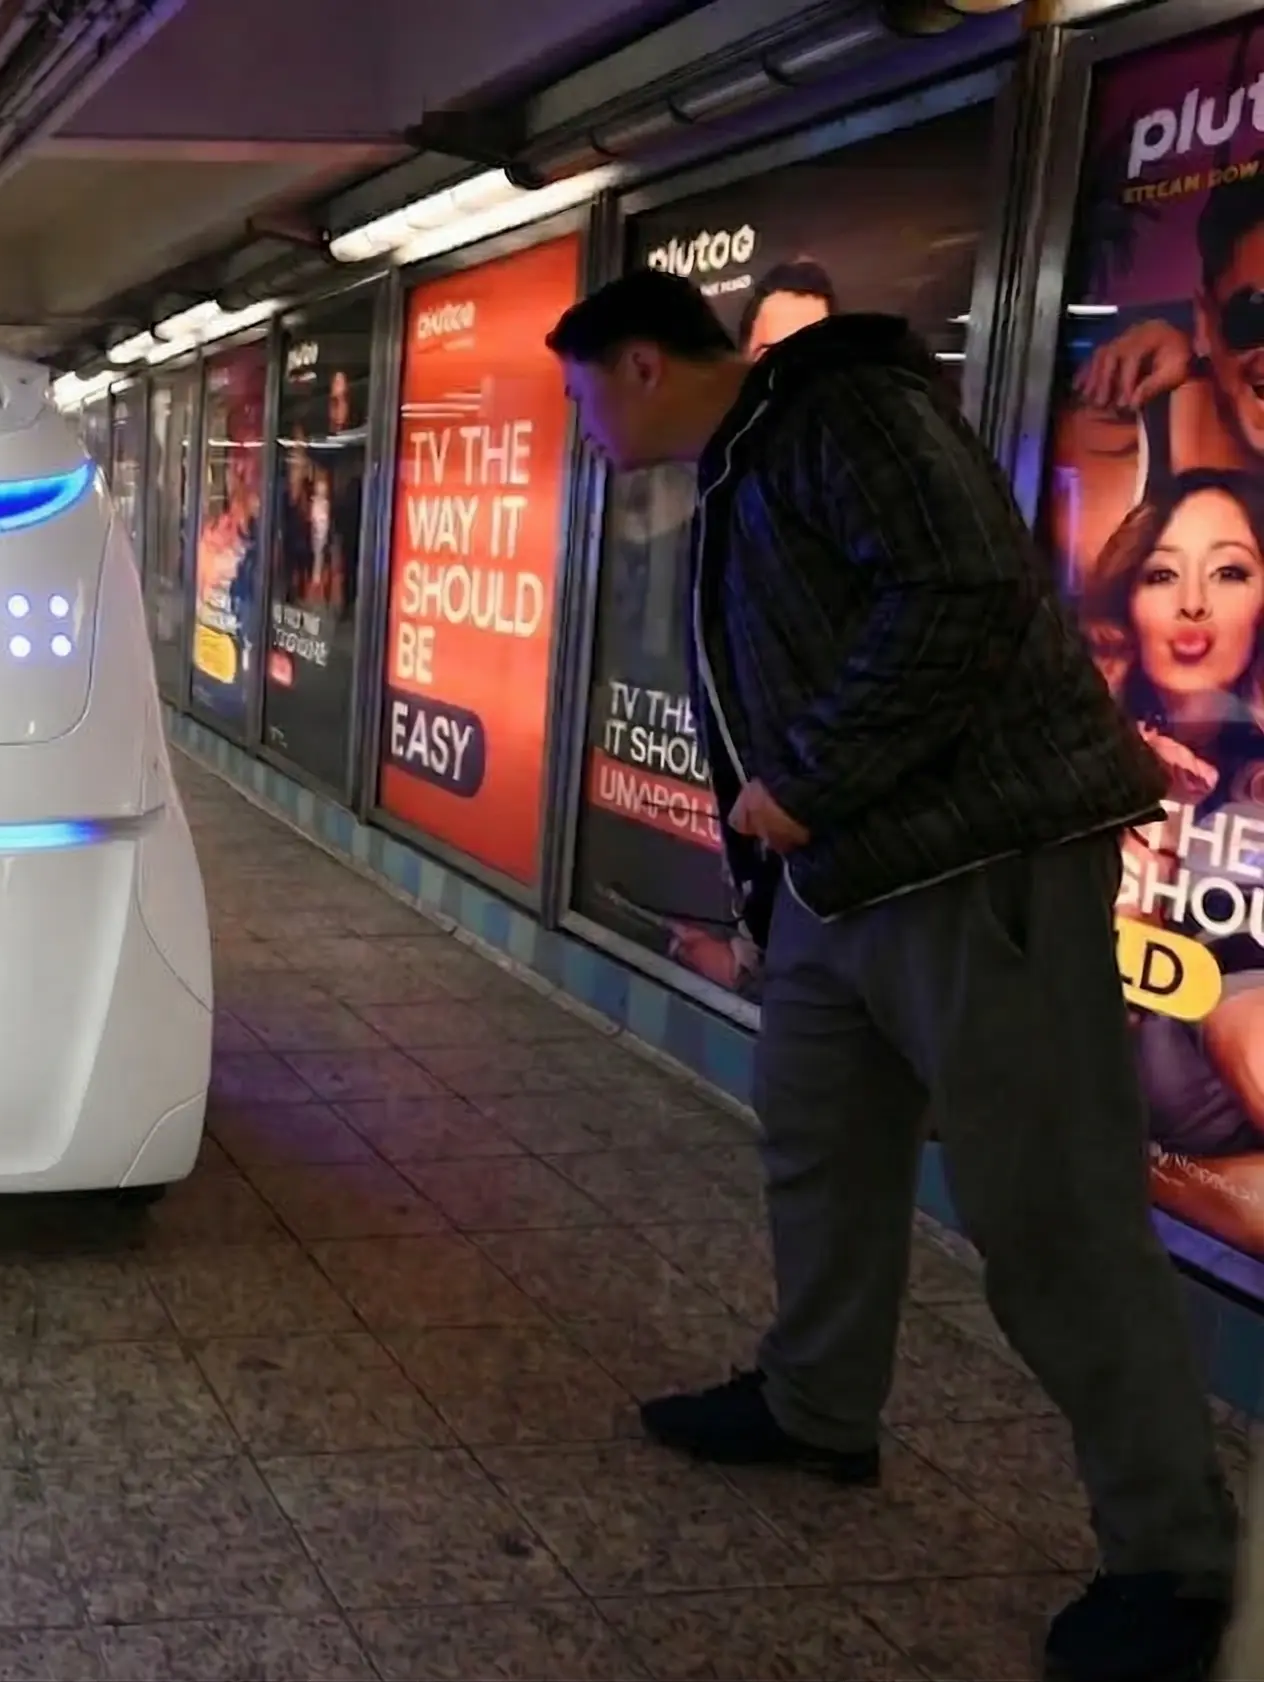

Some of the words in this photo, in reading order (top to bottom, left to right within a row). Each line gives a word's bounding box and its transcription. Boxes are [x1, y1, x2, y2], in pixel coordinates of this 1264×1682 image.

[410, 428, 451, 486] TV
[459, 419, 533, 486] THE
[407, 495, 478, 556] WAY
[490, 495, 528, 559] IT
[400, 560, 544, 638] SHOULD
[396, 621, 435, 685] BE
[604, 719, 628, 756] IT
[610, 680, 640, 720] TV
[646, 688, 696, 734] THE
[391, 700, 474, 781] EASY
